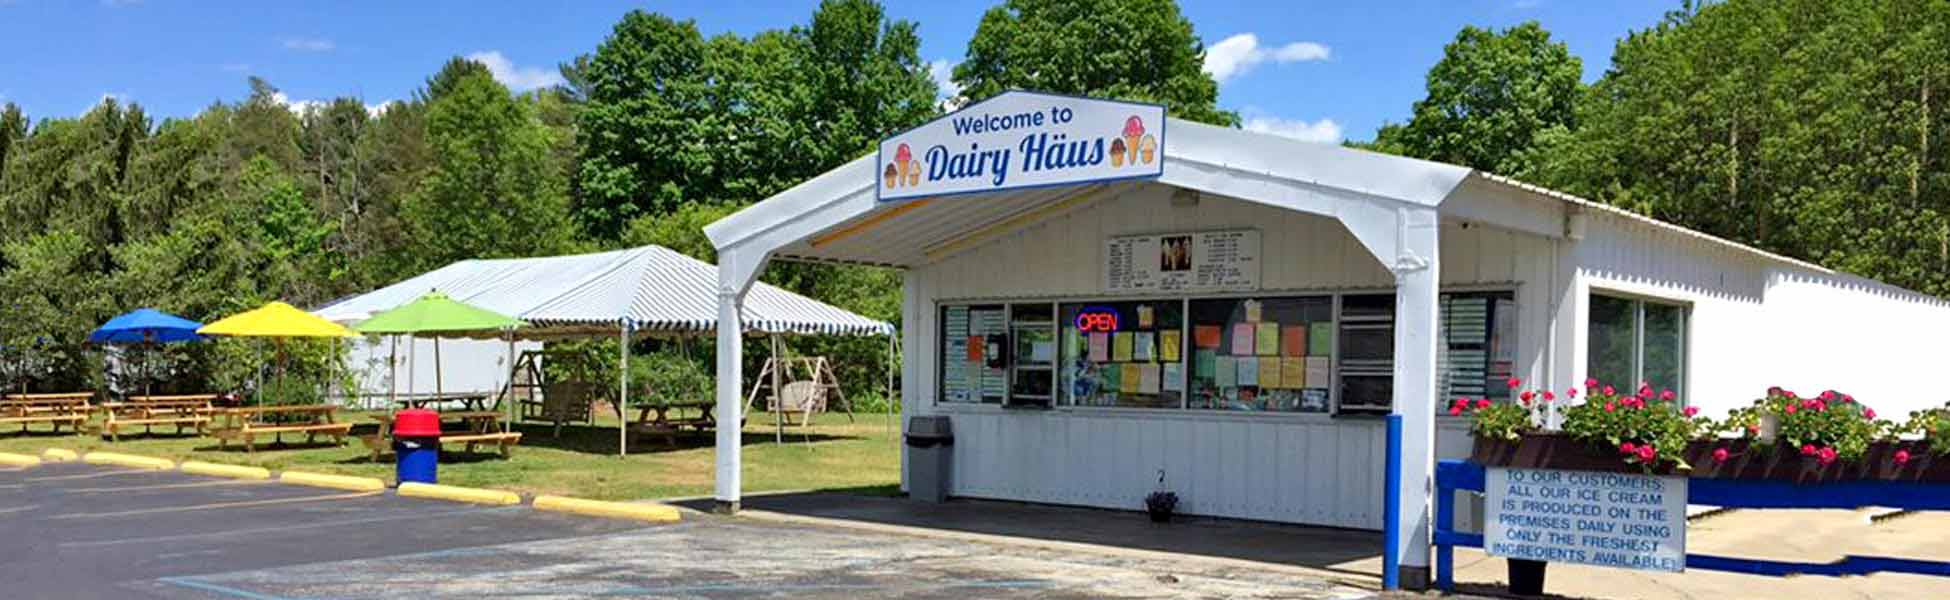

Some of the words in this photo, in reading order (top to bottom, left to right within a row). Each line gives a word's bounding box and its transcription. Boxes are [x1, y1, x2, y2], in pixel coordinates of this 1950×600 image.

[953, 110, 1044, 136] Welcome
[1051, 105, 1073, 125] to
[925, 143, 1011, 186] Dairy
[1019, 133, 1105, 173] Häus
[1077, 312, 1118, 331] OPEN
[1507, 470, 1525, 482] TO
[1531, 470, 1561, 483] OUR
[1508, 485, 1533, 497] ALL
[1539, 487, 1570, 499] OUR
[1577, 489, 1600, 501] ICE
[1608, 491, 1663, 505] CREAM
[1502, 499, 1515, 511] IS
[1522, 500, 1600, 516] PRODUCED
[1608, 508, 1630, 520] ON
[1639, 509, 1667, 522] THE
[1499, 514, 1570, 529] PREMISES
[1577, 519, 1616, 532] DAILY
[1623, 524, 1670, 538] USING
[1506, 528, 1542, 542] ONLY
[1549, 533, 1575, 546] THE
[1582, 536, 1660, 552] FRESHEST
[1493, 543, 1585, 561] INGREDIENTS
